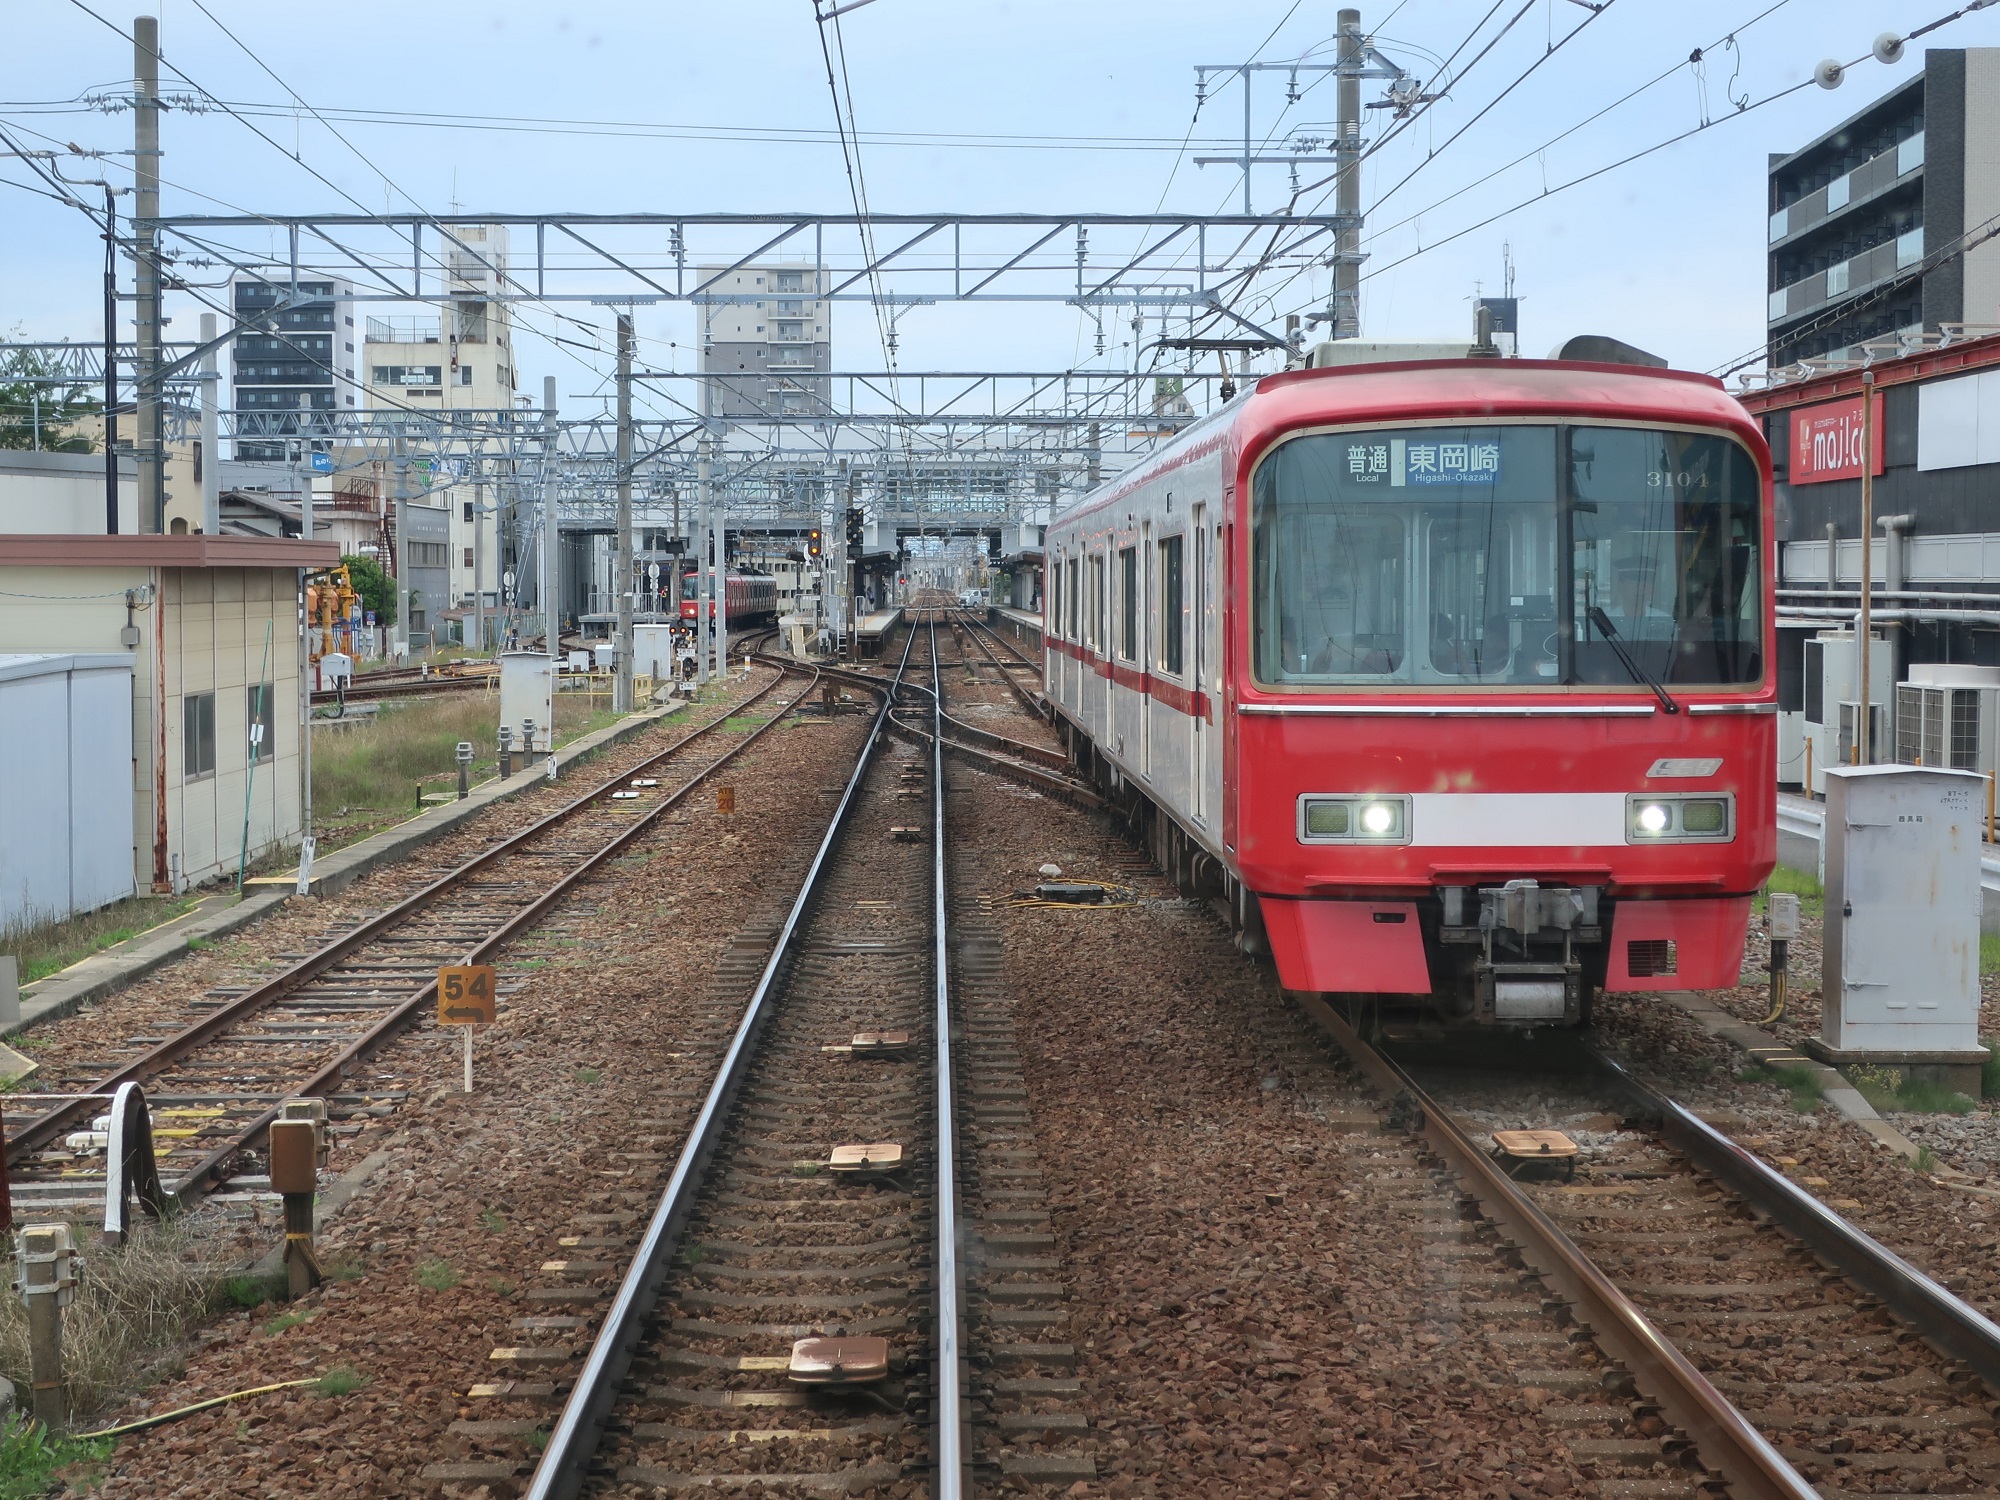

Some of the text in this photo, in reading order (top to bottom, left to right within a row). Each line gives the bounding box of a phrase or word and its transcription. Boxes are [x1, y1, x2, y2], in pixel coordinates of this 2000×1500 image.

[1347, 445, 1388, 474] 普通
[1408, 443, 1500, 473] 東岡崎
[1356, 474, 1379, 482] Local
[1415, 473, 1493, 484] Higashi-Okazaki
[1647, 471, 1709, 488] 3104
[718, 798, 734, 810] 20
[444, 972, 489, 1001] 54
